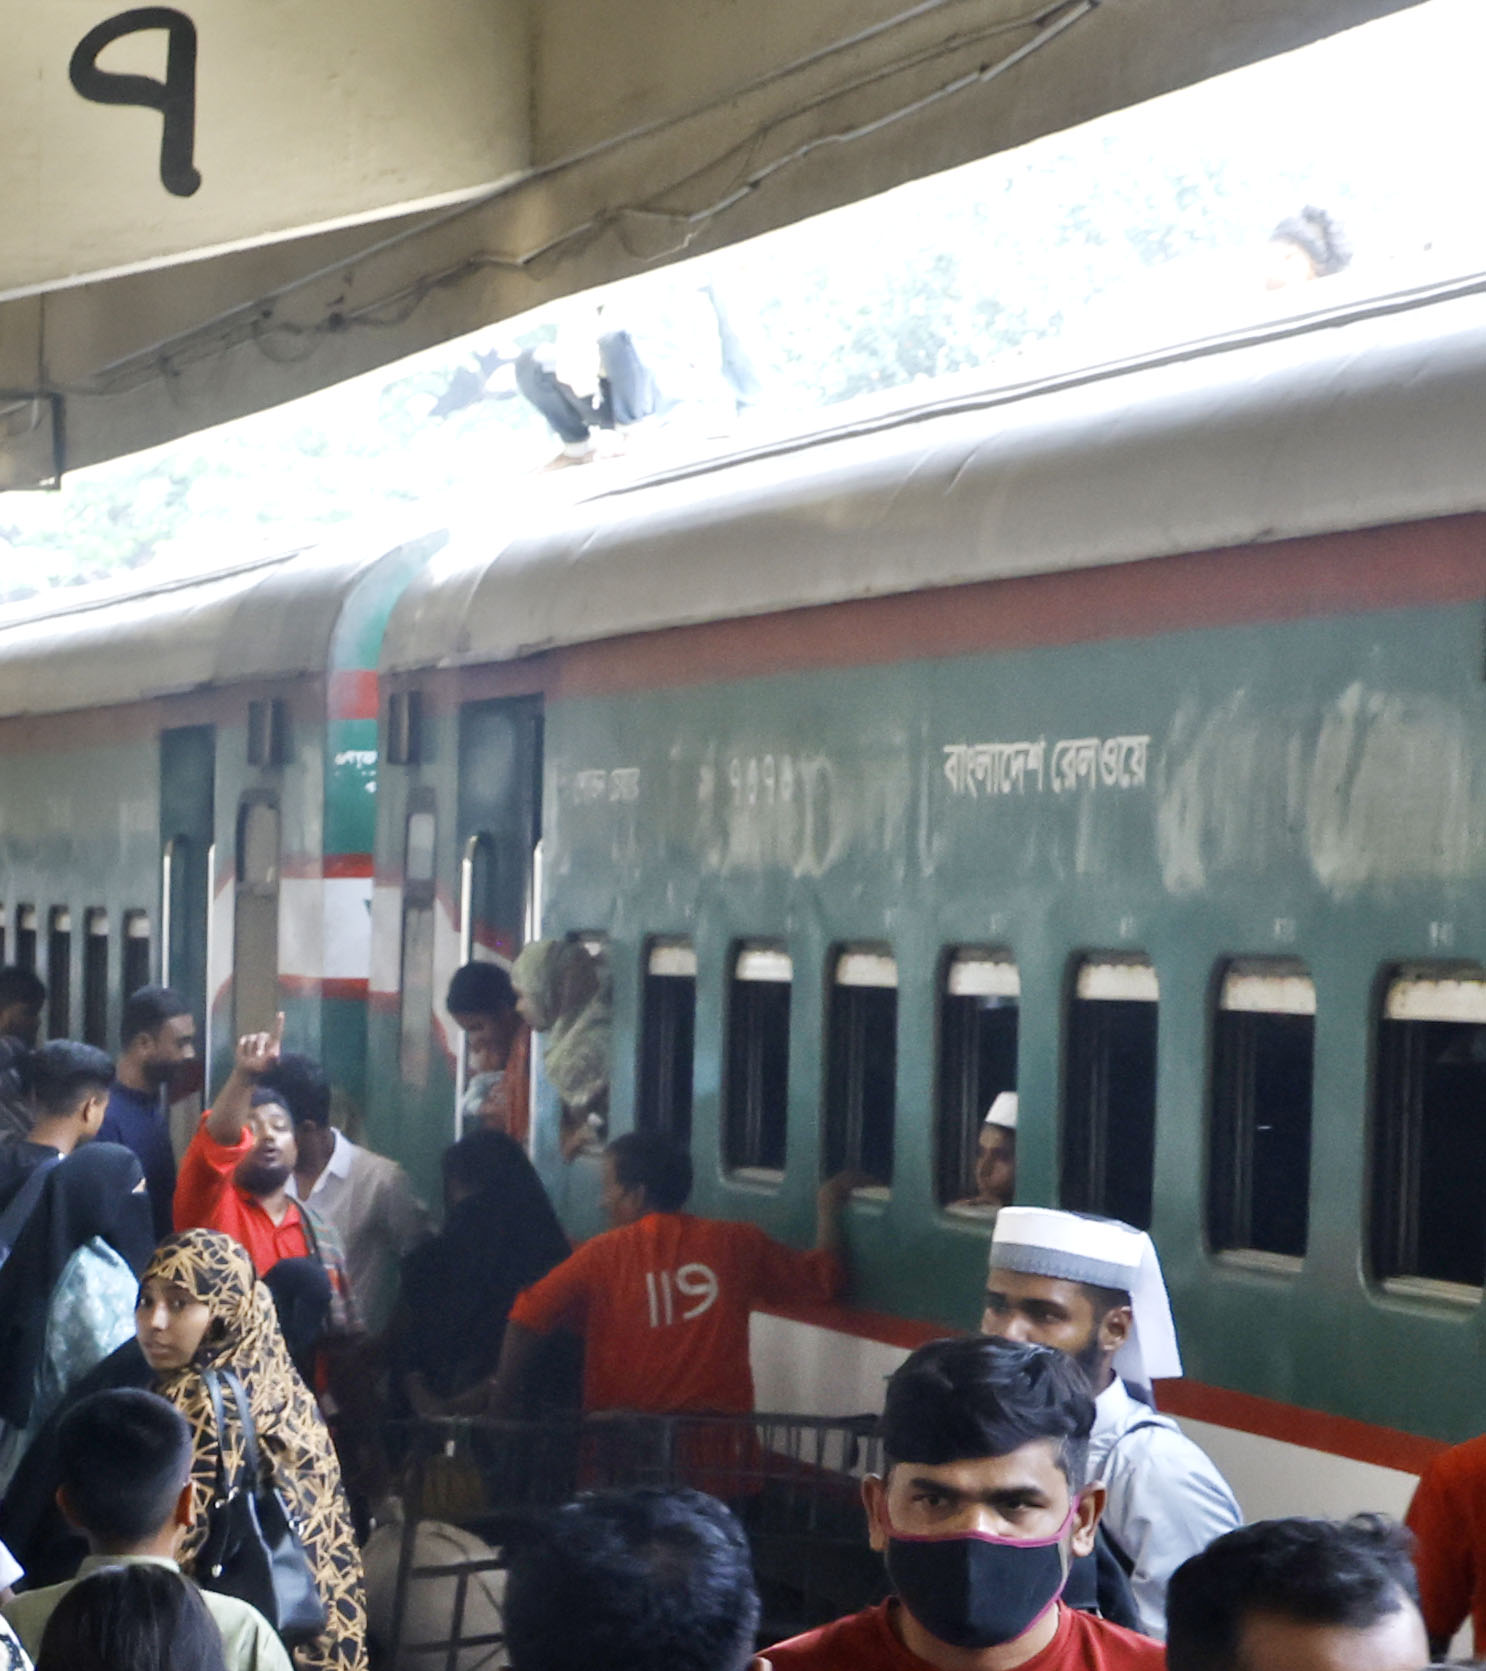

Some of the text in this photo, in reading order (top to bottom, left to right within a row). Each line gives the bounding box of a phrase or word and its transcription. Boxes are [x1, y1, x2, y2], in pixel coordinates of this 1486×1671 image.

[68, 7, 202, 198] ৭
[943, 733, 1151, 799] বাংলাদেশ রেলওয়ে
[645, 1262, 720, 1328] 119
